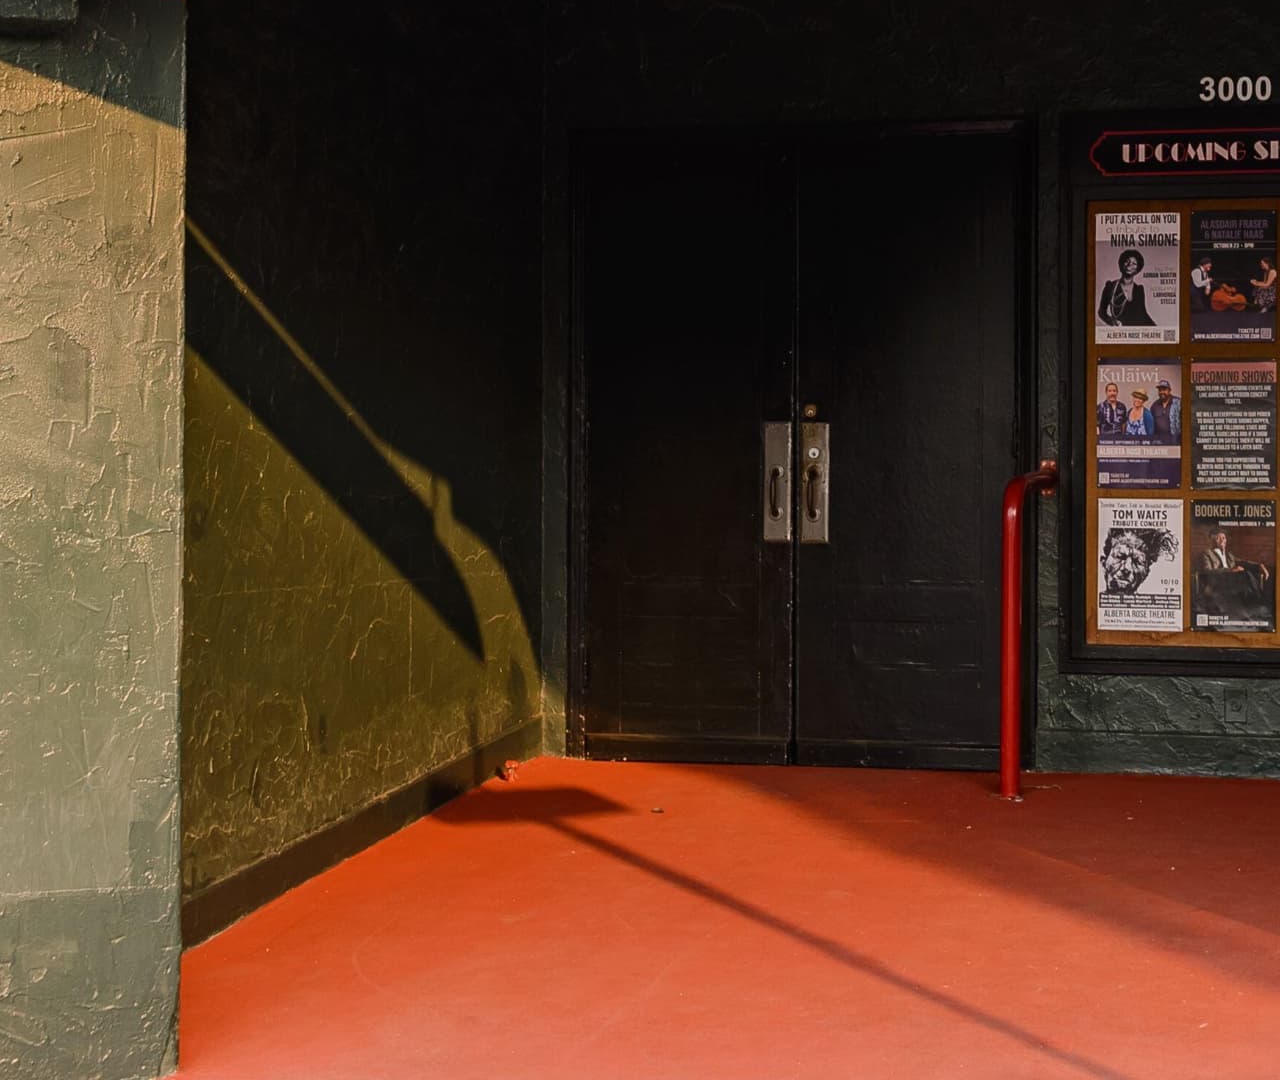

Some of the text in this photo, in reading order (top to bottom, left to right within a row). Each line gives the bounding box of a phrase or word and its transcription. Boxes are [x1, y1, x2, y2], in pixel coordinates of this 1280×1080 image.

[1200, 76, 1272, 102] 3000
[1122, 143, 1246, 164] UPCOMING
[1105, 215, 1119, 225] PUT
[1127, 215, 1149, 225] SPELL
[1151, 215, 1161, 224] ON
[1163, 214, 1177, 224] YOU
[1110, 233, 1178, 248] NINA SIMONE
[1192, 370, 1274, 383] UPCOMING SHOWS
[1112, 510, 1168, 520] TOM WAITS
[1195, 504, 1232, 517] BOOKER
[1243, 505, 1272, 518] JONES
[1103, 609, 1176, 619] ALBERTA ROSE THEATRE
